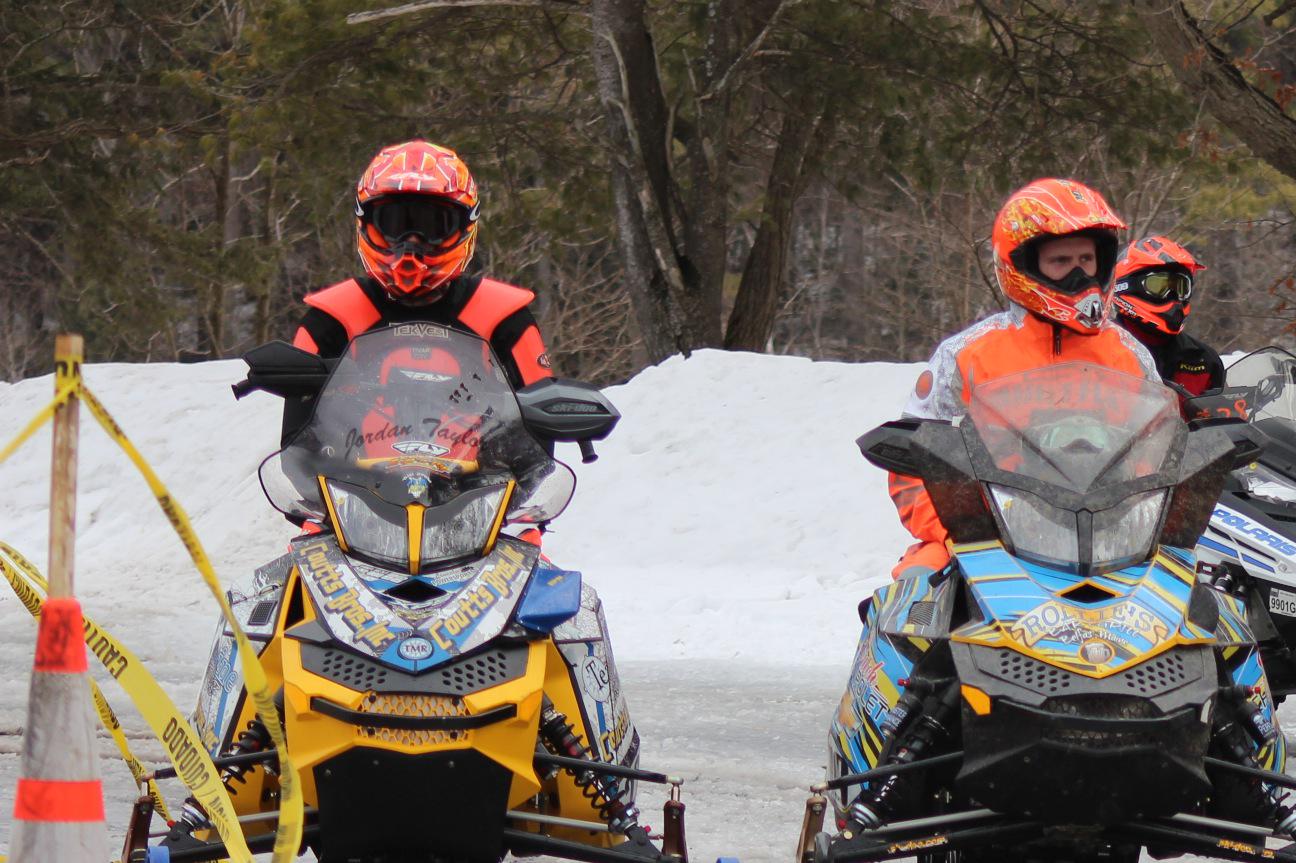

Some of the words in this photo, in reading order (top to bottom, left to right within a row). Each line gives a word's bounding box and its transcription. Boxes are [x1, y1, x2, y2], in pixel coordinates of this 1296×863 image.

[345, 422, 412, 460] Jordan
[423, 418, 484, 449] Taylo
[301, 543, 342, 594] Coutts
[428, 585, 495, 650] Coutts
[404, 644, 428, 654] TMR
[161, 717, 211, 791] CUIDADO
